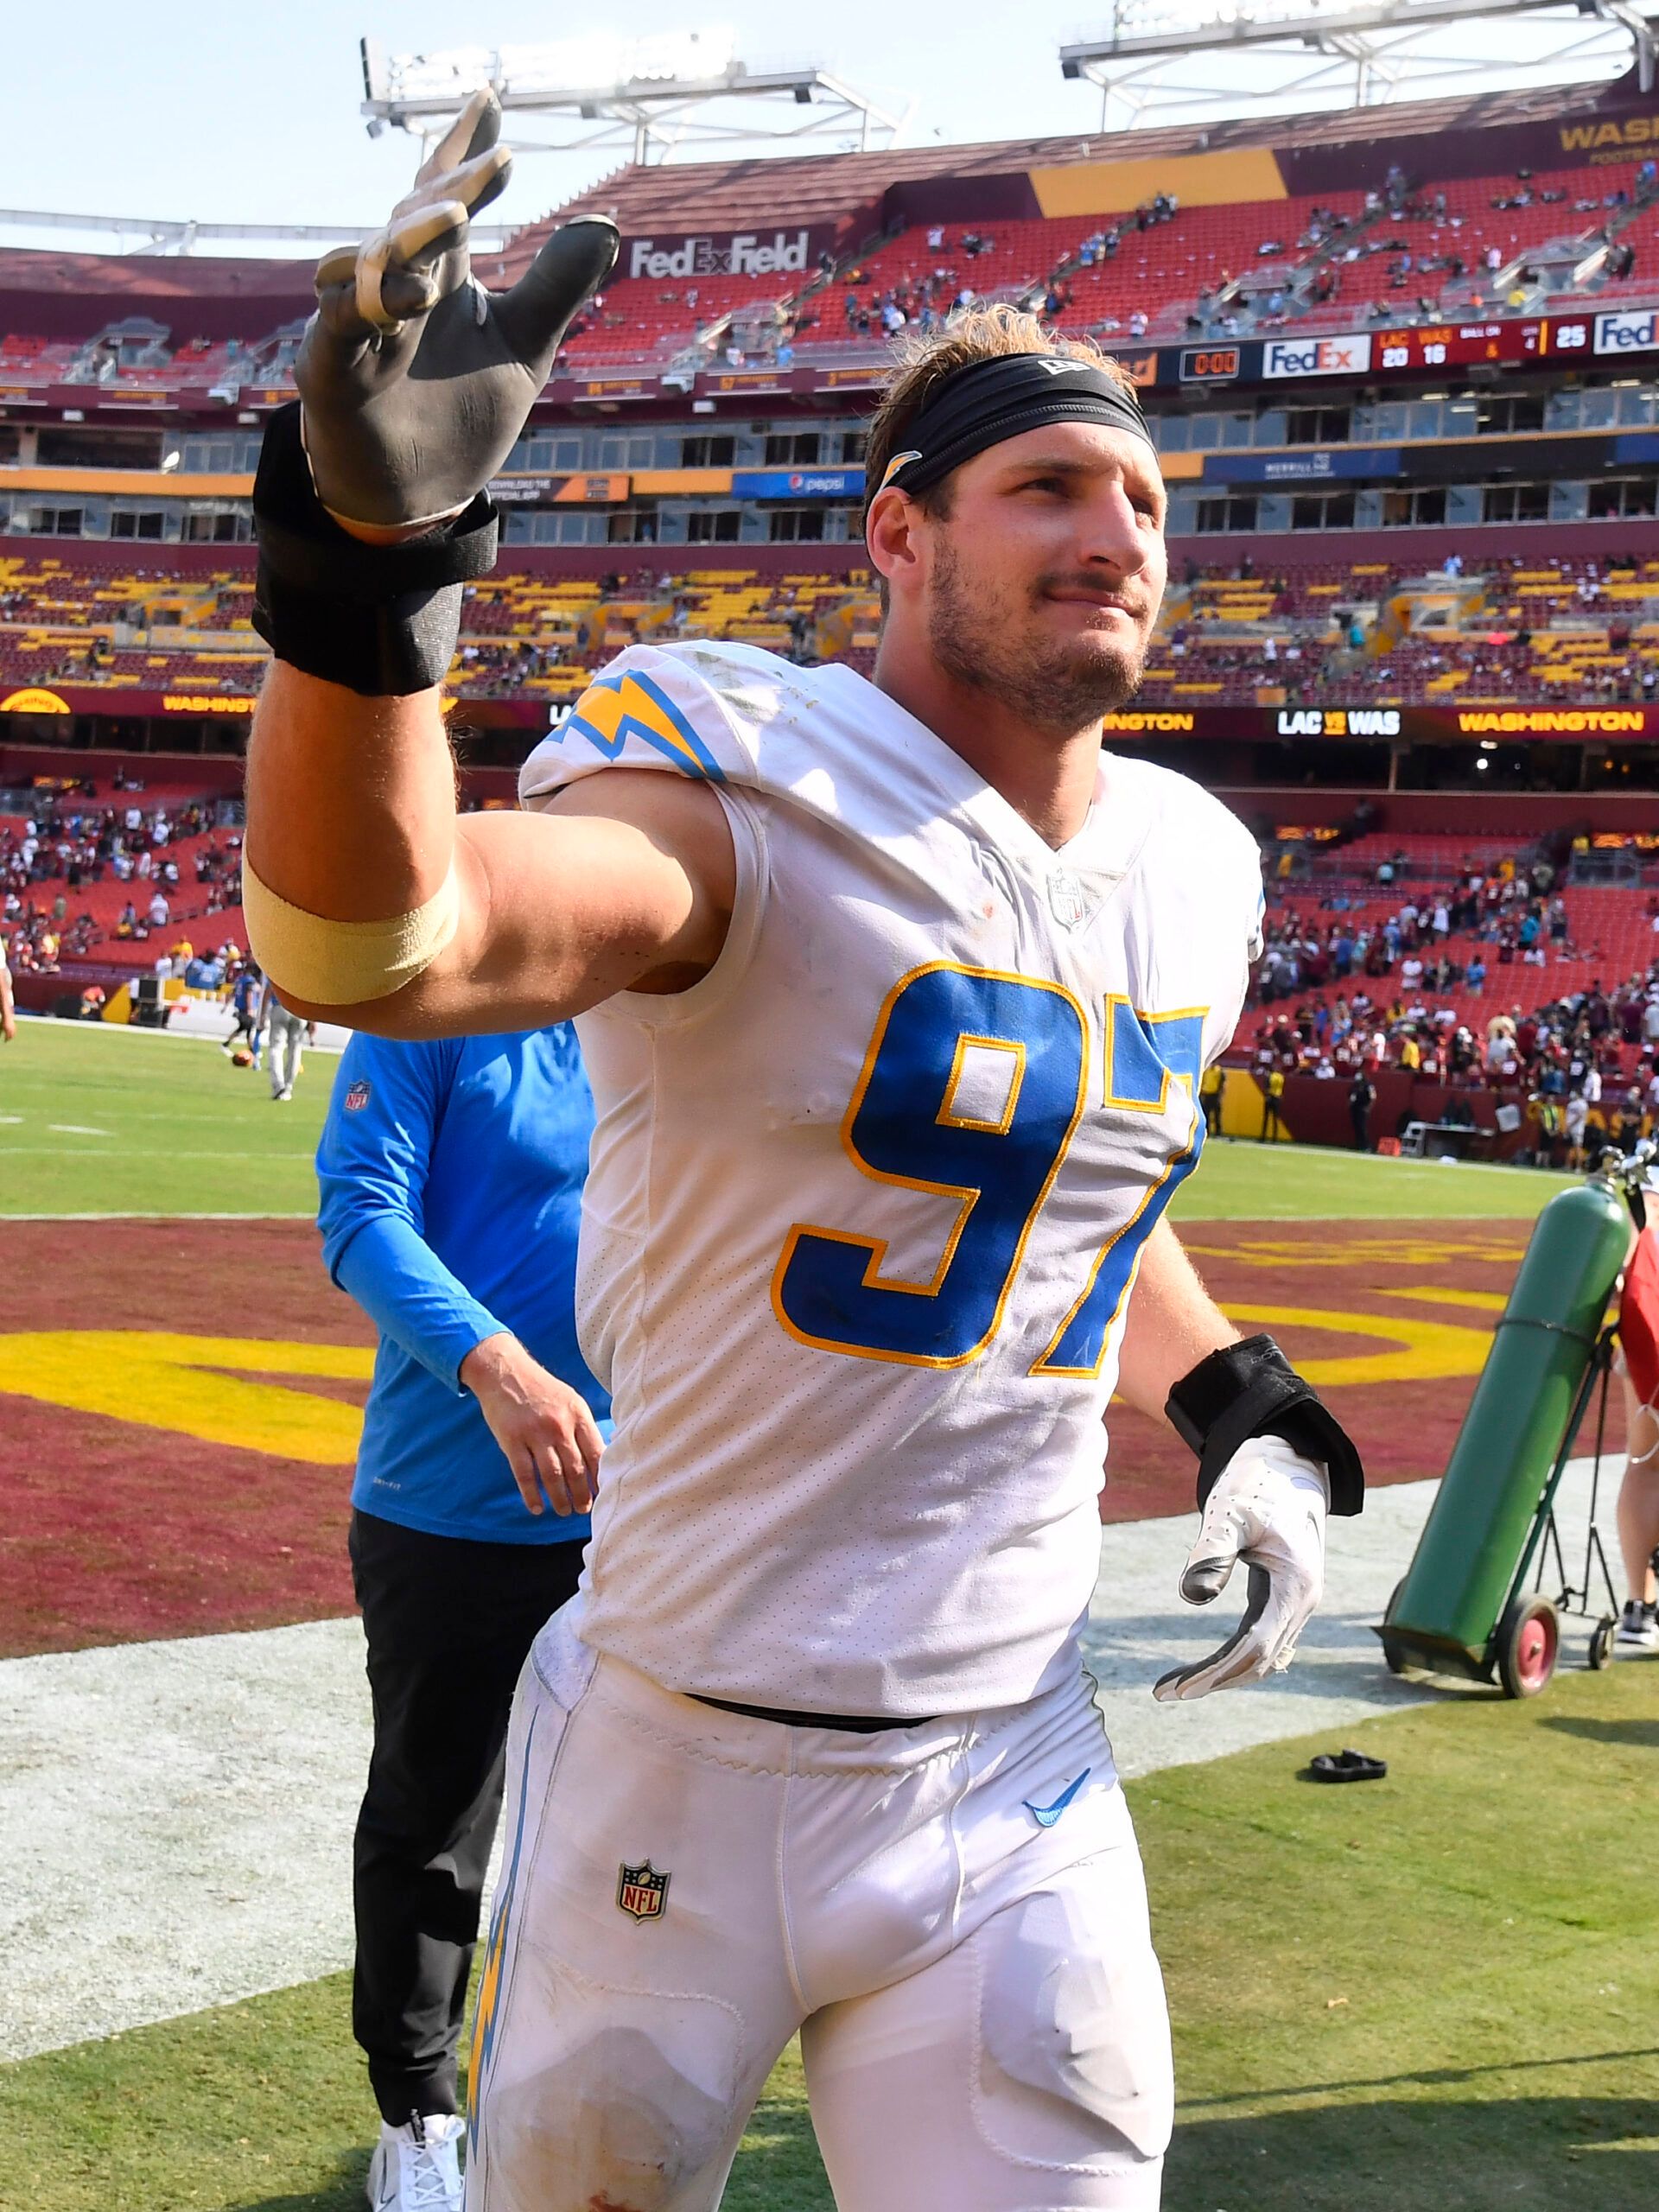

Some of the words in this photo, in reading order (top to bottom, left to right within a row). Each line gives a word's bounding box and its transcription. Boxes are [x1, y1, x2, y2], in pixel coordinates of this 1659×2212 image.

[1560, 118, 1659, 151] WAS
[630, 231, 809, 278] FedExField
[1379, 331, 1409, 348] LAC
[1556, 324, 1586, 348] 25
[1602, 315, 1659, 347] Fed
[1271, 341, 1351, 372] FedEx
[1382, 346, 1408, 368] 20
[1423, 344, 1446, 365] 16
[805, 477, 844, 493] pepsi
[1278, 711, 1322, 734] LAC
[1348, 711, 1400, 734] WAS
[1459, 711, 1644, 732] WASHINGTON
[771, 959, 1211, 1378] 97
[623, 1885, 658, 1913] NFL
